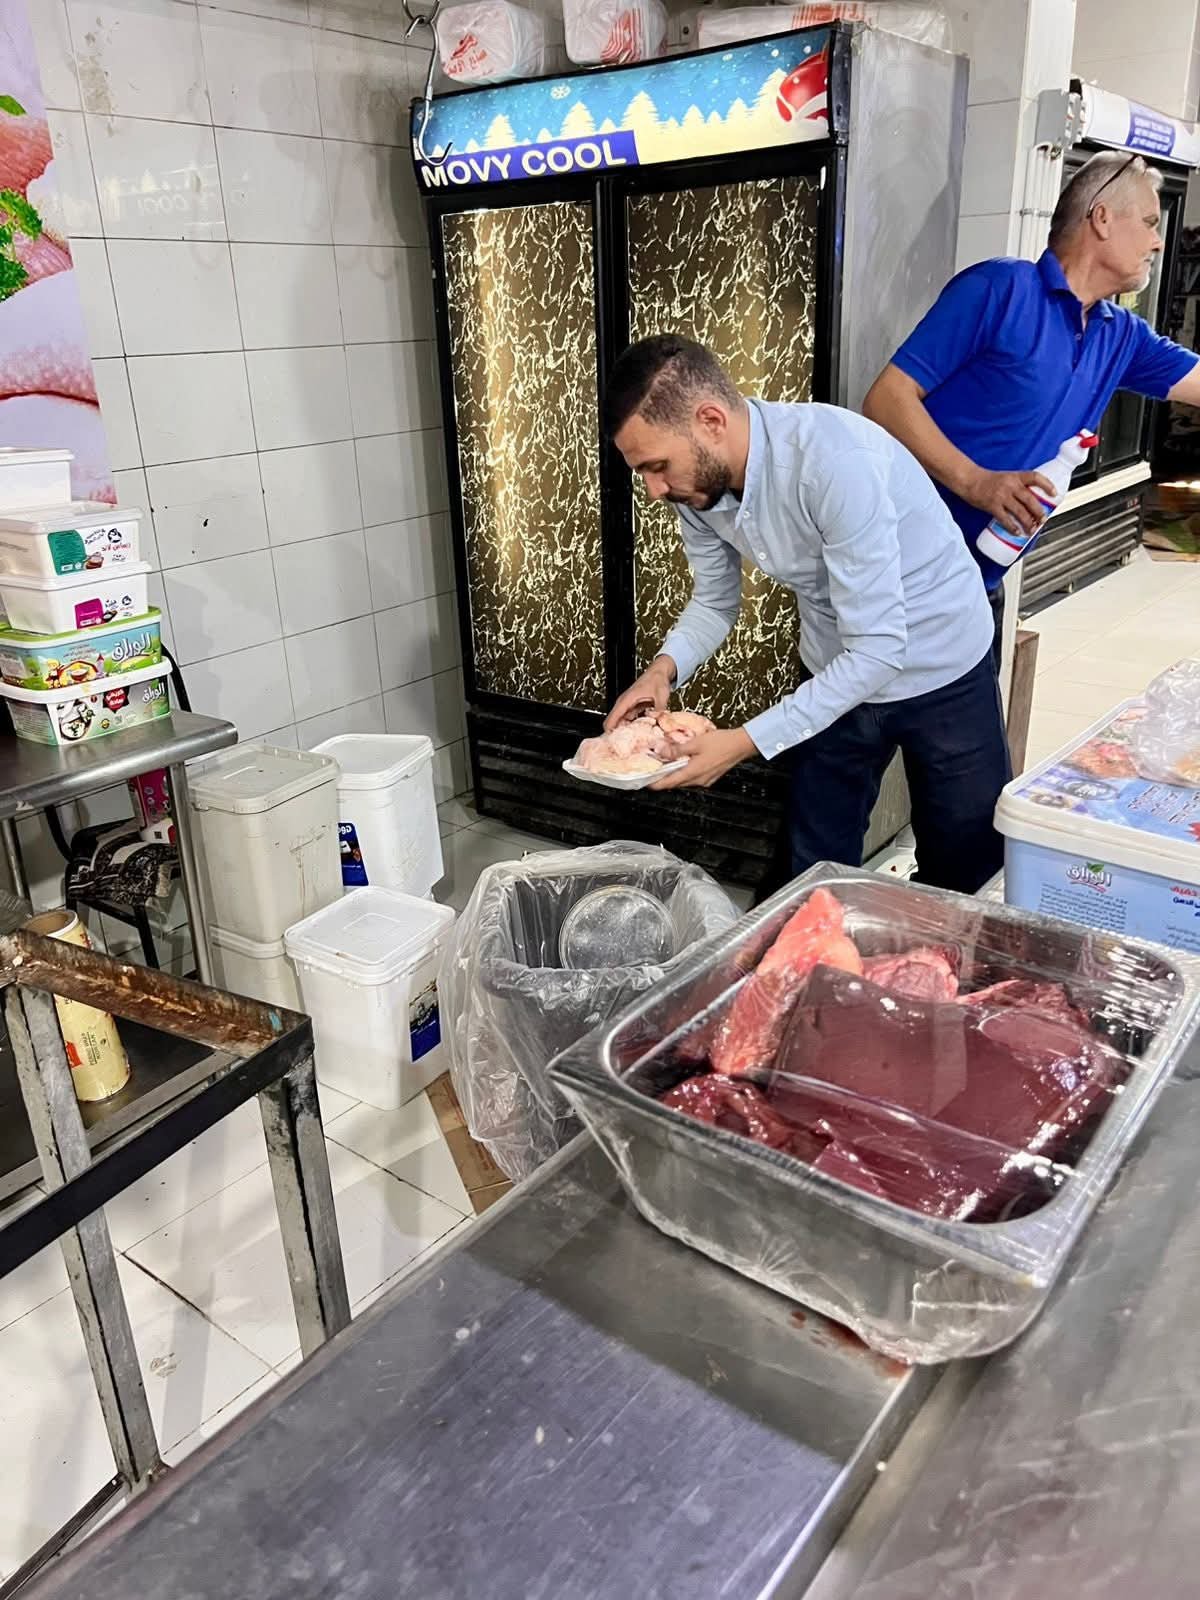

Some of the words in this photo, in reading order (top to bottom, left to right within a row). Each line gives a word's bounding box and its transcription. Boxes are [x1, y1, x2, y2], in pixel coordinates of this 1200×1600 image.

[421, 153, 512, 188] MOVY
[521, 139, 627, 176] COOL
[112, 632, 152, 662] الوراق
